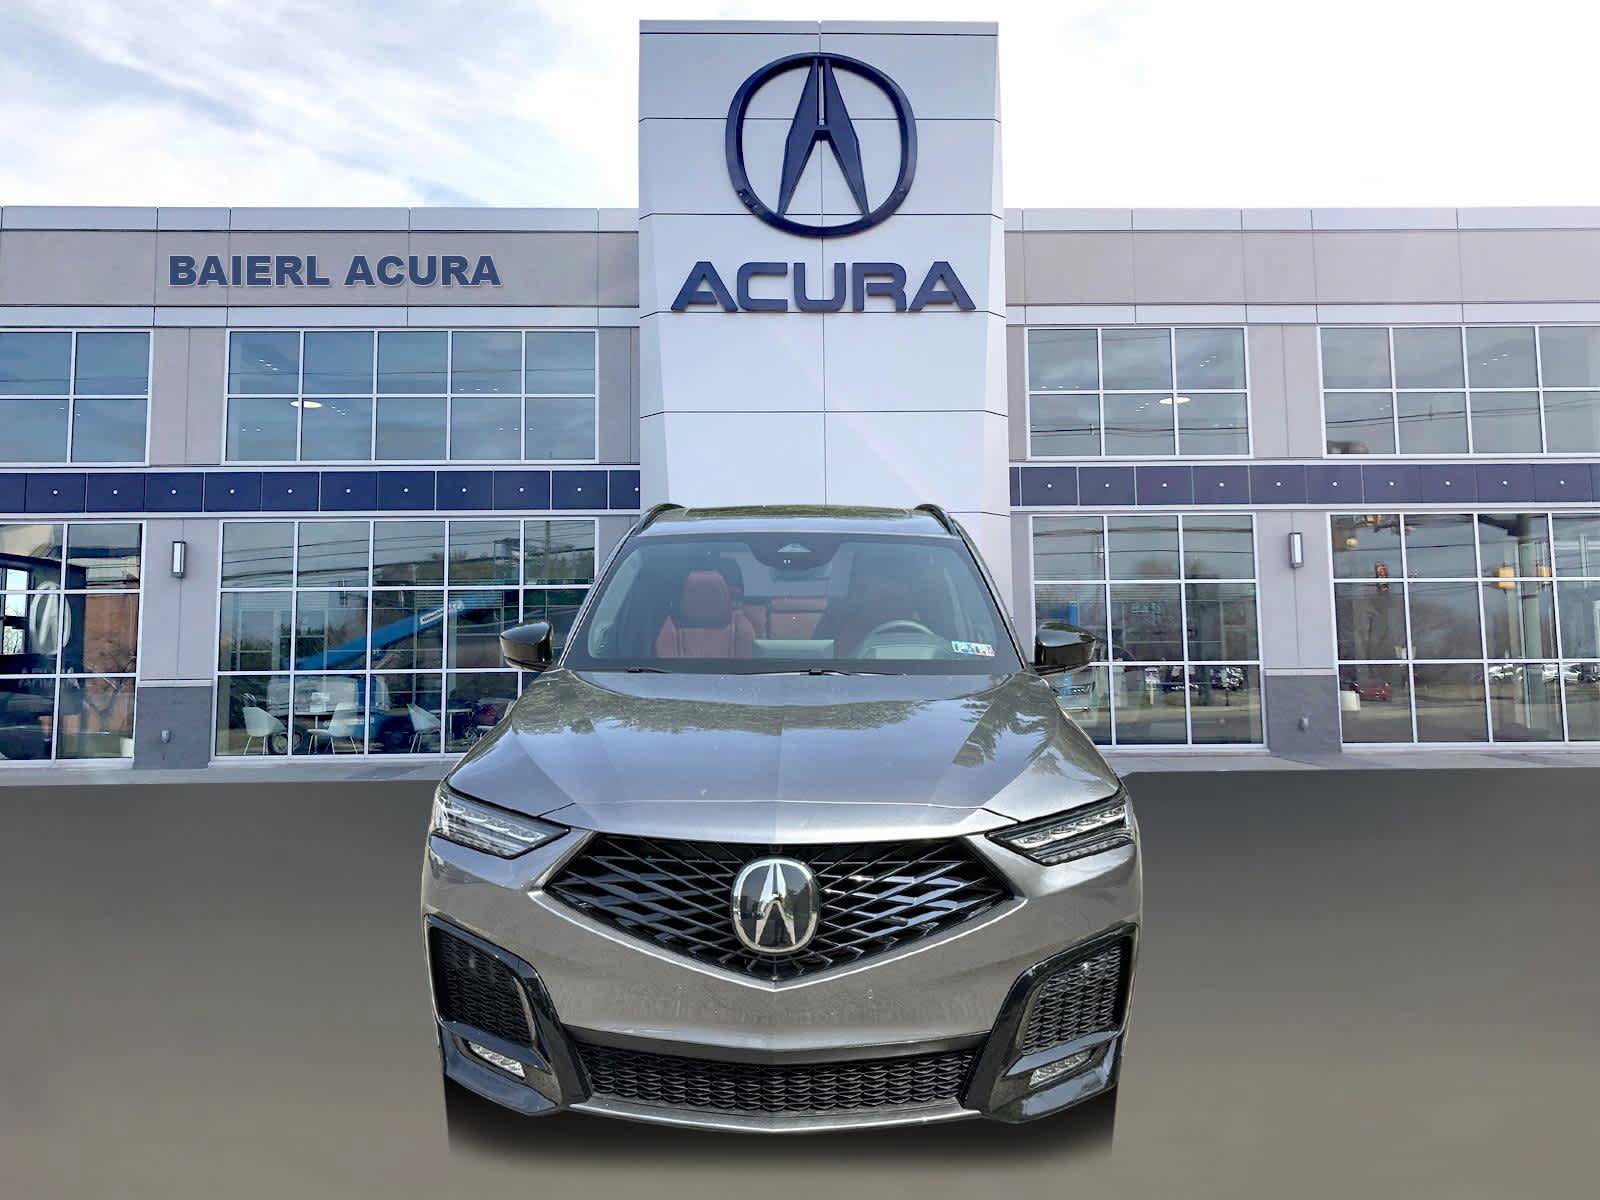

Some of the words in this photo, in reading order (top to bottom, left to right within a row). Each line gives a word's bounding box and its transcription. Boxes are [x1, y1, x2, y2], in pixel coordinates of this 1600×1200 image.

[168, 255, 331, 287] BAIERL
[343, 255, 502, 287] ACURA
[670, 261, 977, 313] ACURA
